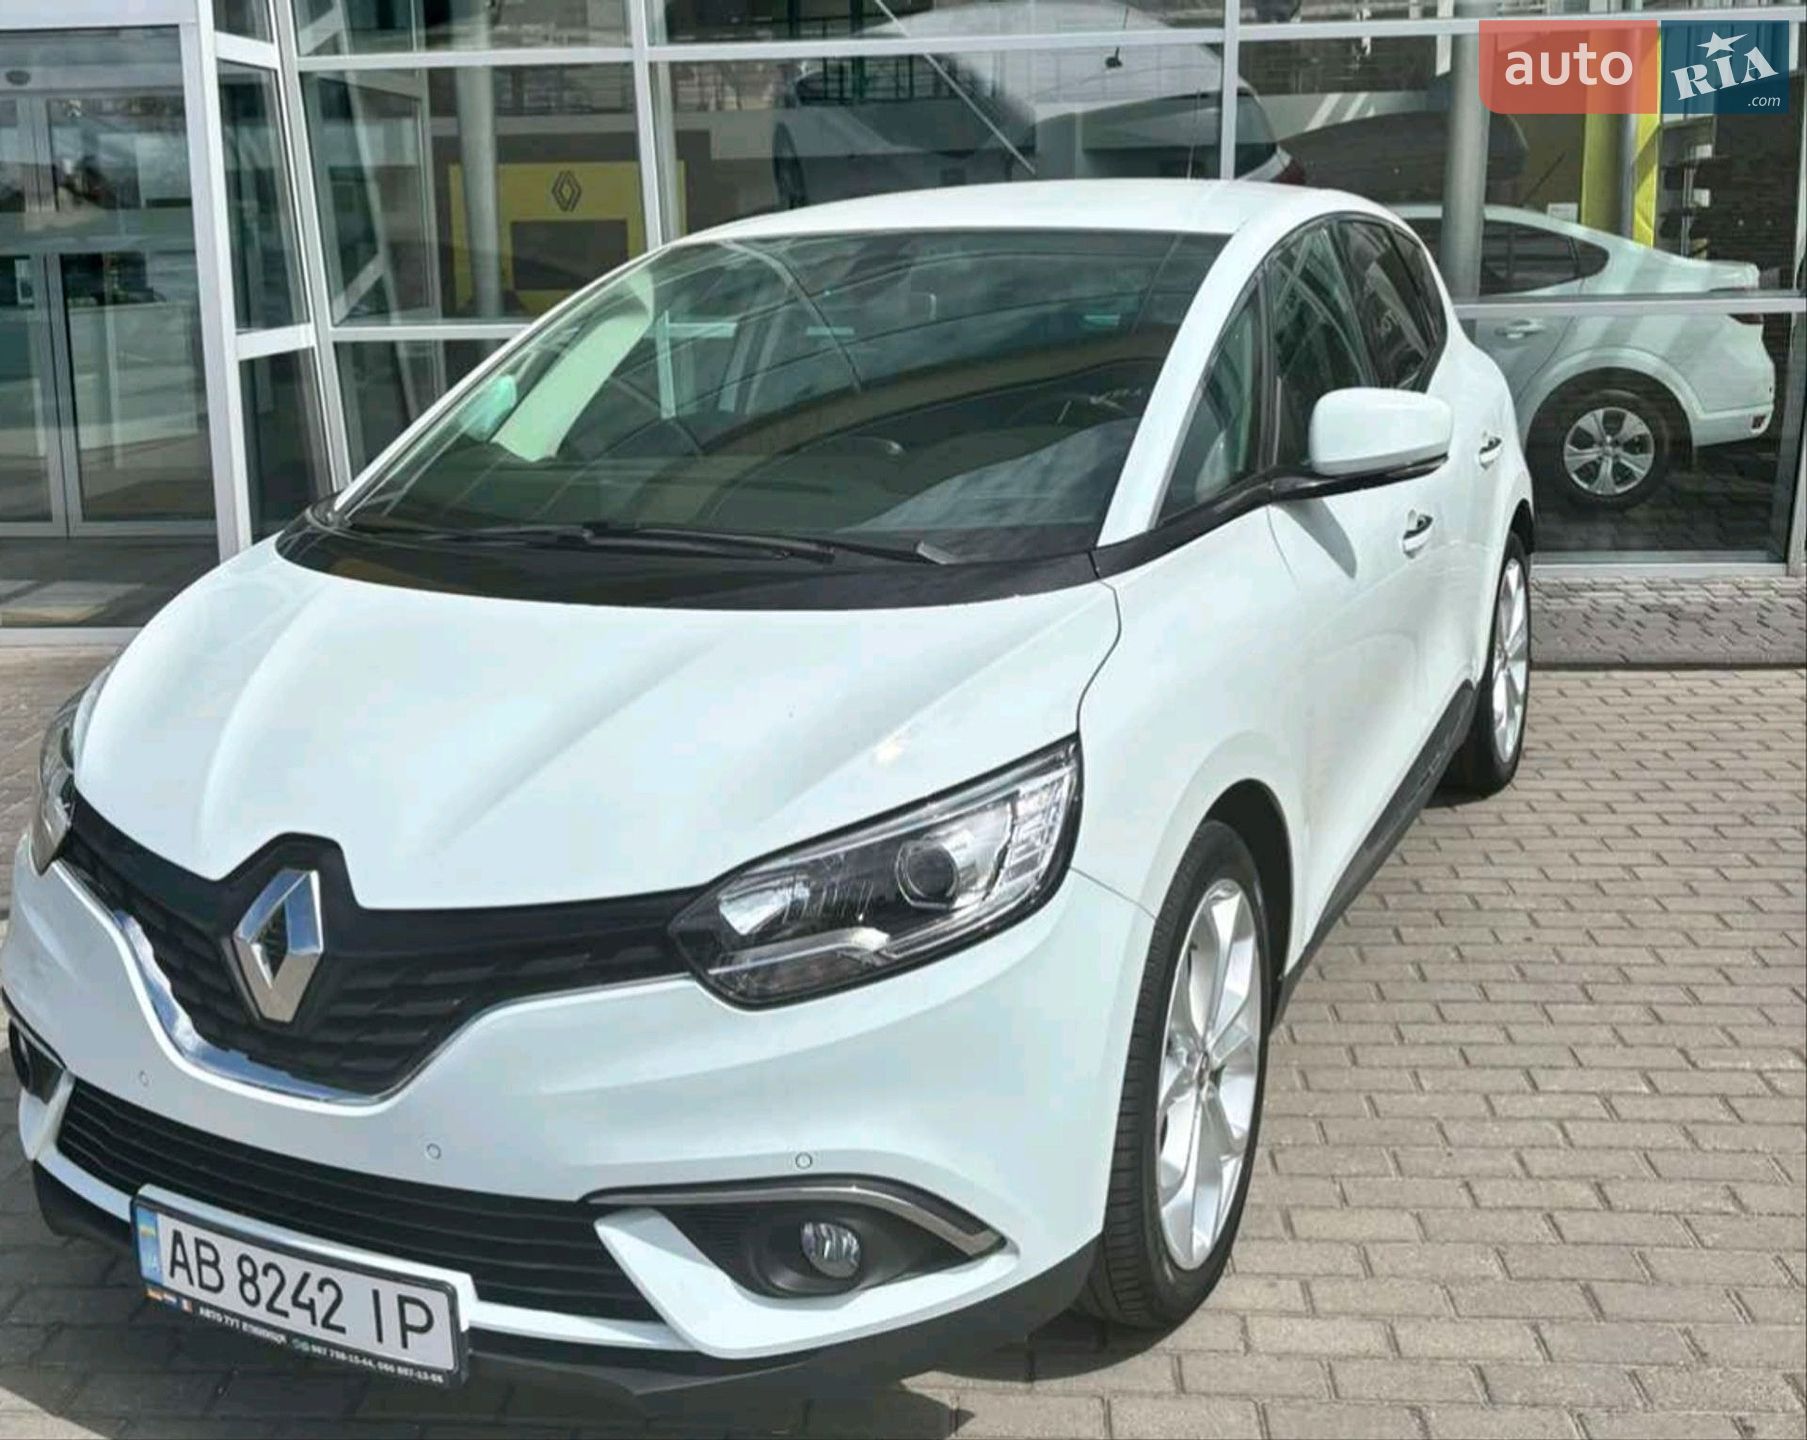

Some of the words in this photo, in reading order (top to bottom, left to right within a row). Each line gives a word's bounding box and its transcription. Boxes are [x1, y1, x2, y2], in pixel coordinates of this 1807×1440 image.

[169, 1229, 225, 1294] AB
[236, 1253, 346, 1334] 8242
[371, 1288, 434, 1349] IP
